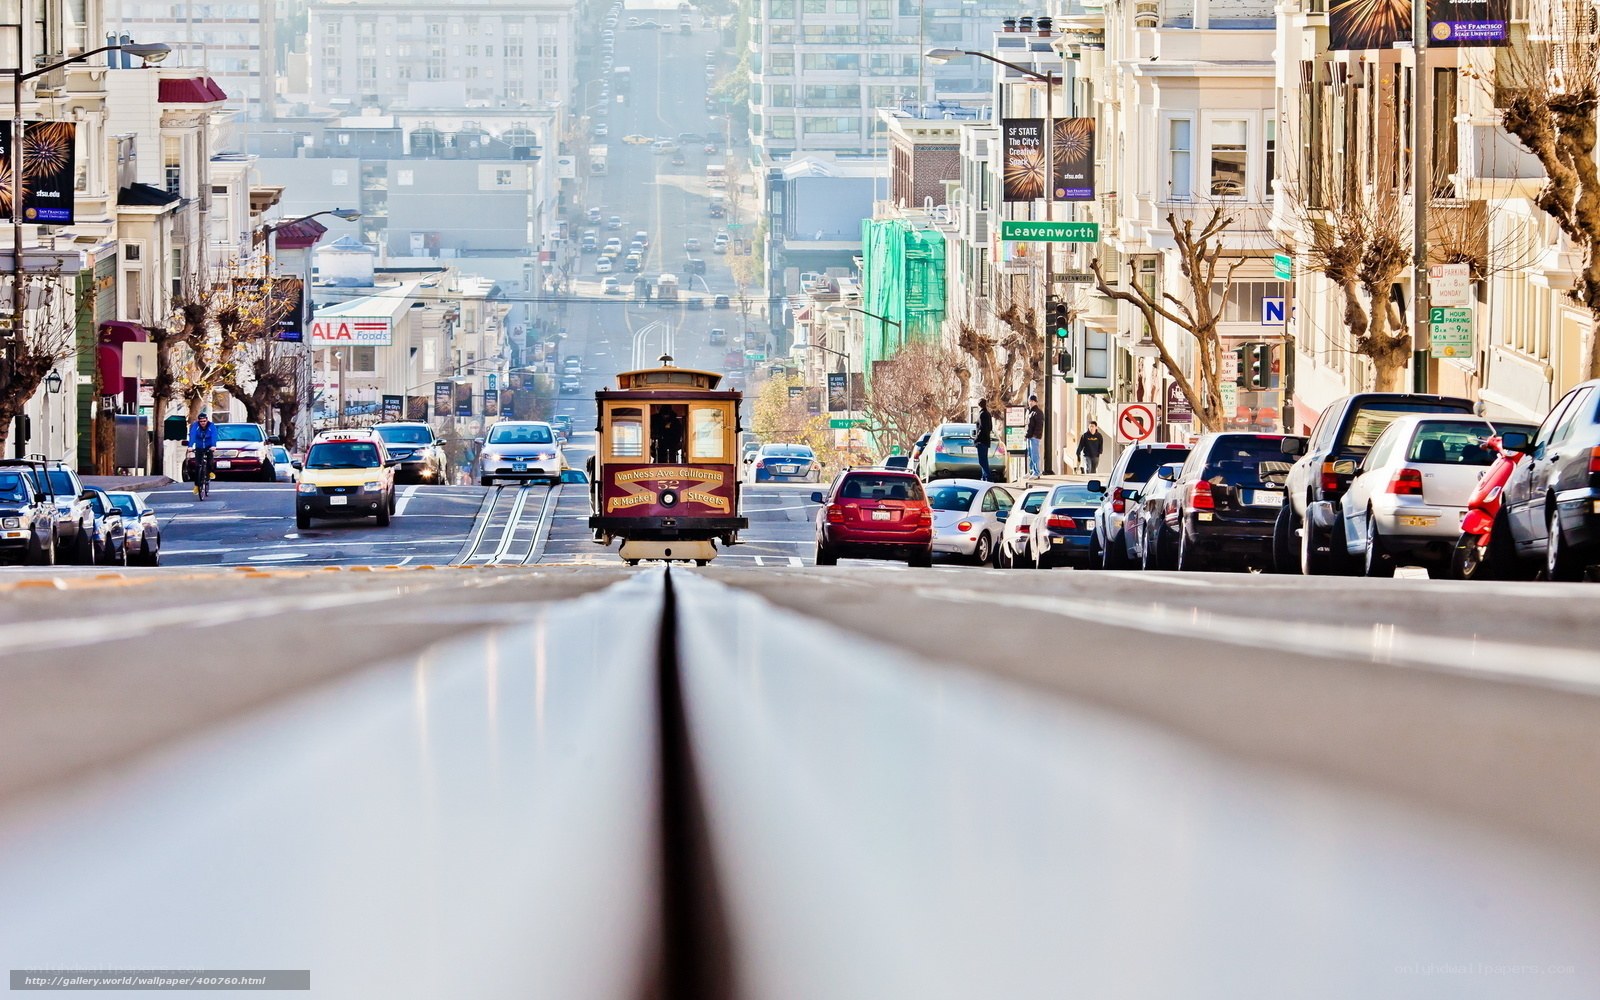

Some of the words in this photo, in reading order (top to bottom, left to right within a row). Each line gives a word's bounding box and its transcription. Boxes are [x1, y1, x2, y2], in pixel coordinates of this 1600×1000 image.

[1008, 128, 1017, 136] SF
[1018, 128, 1037, 136] STATE
[1008, 138, 1020, 146] The
[1022, 138, 1039, 146] City's
[1009, 148, 1037, 156] Creative
[1006, 226, 1094, 238] Leavenworth
[1432, 266, 1442, 276] NO
[1434, 311, 1442, 320] 2
[313, 323, 351, 340] ALA
[356, 330, 387, 340] Foods
[633, 471, 654, 479] Ness
[679, 469, 722, 480] California
[658, 480, 679, 490] 52
[613, 498, 620, 506] &
[620, 494, 652, 505] Market
[687, 492, 724, 505] Streets
